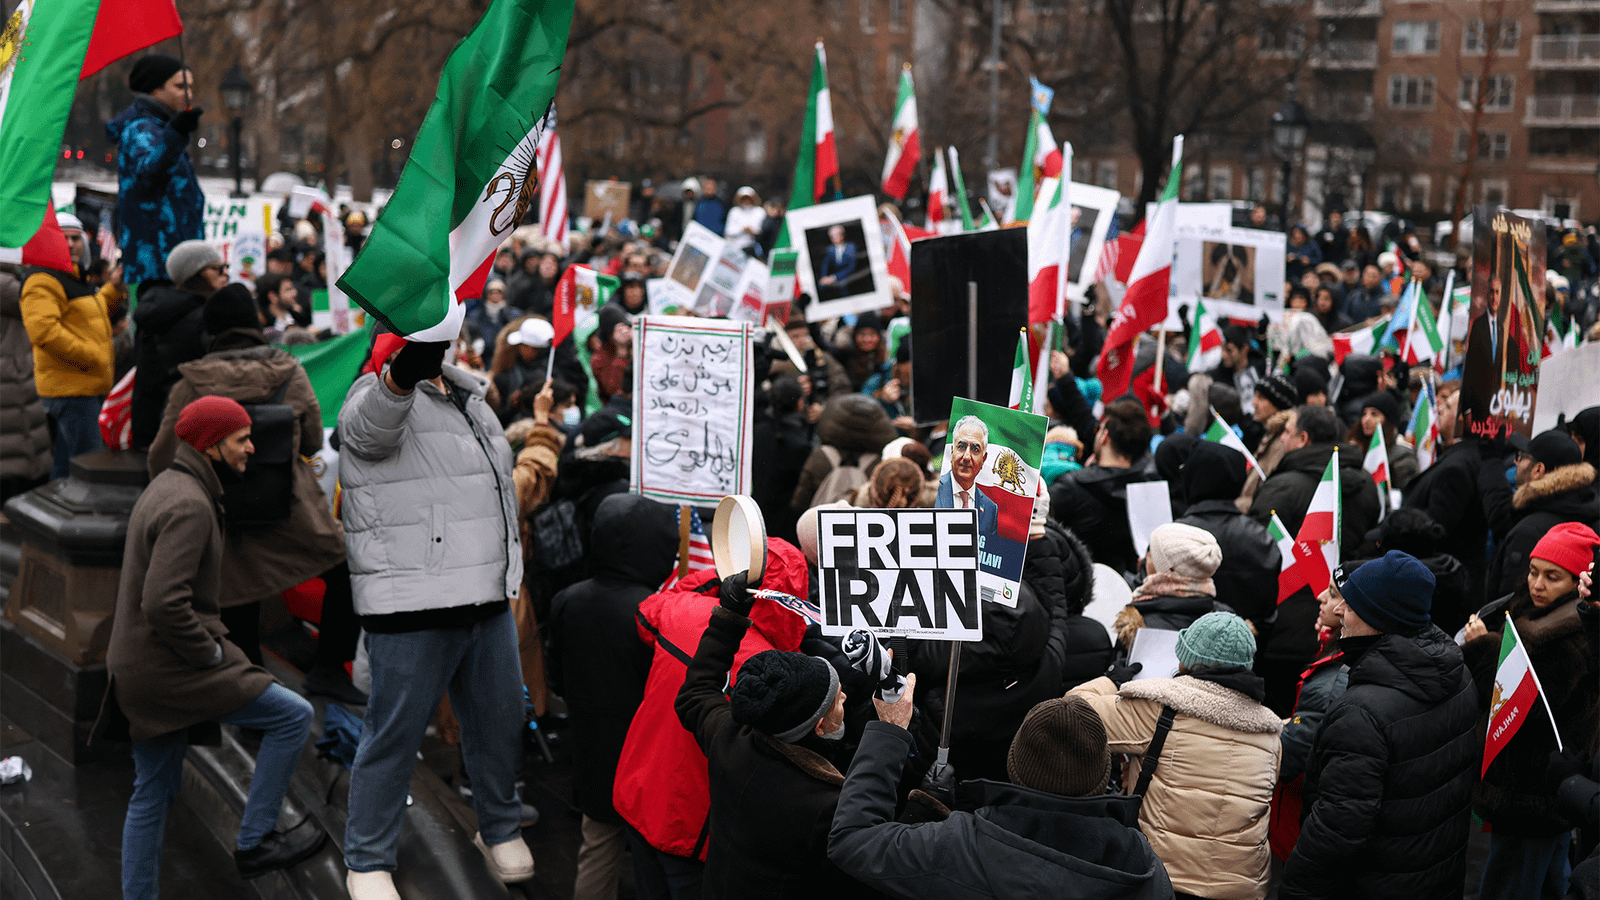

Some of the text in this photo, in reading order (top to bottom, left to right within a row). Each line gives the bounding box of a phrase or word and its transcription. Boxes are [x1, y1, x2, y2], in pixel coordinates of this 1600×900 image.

[1489, 382, 1532, 424] پهلوی
[645, 421, 735, 492] پهلوی
[820, 512, 977, 569] FREE
[823, 568, 979, 630] IRAN
